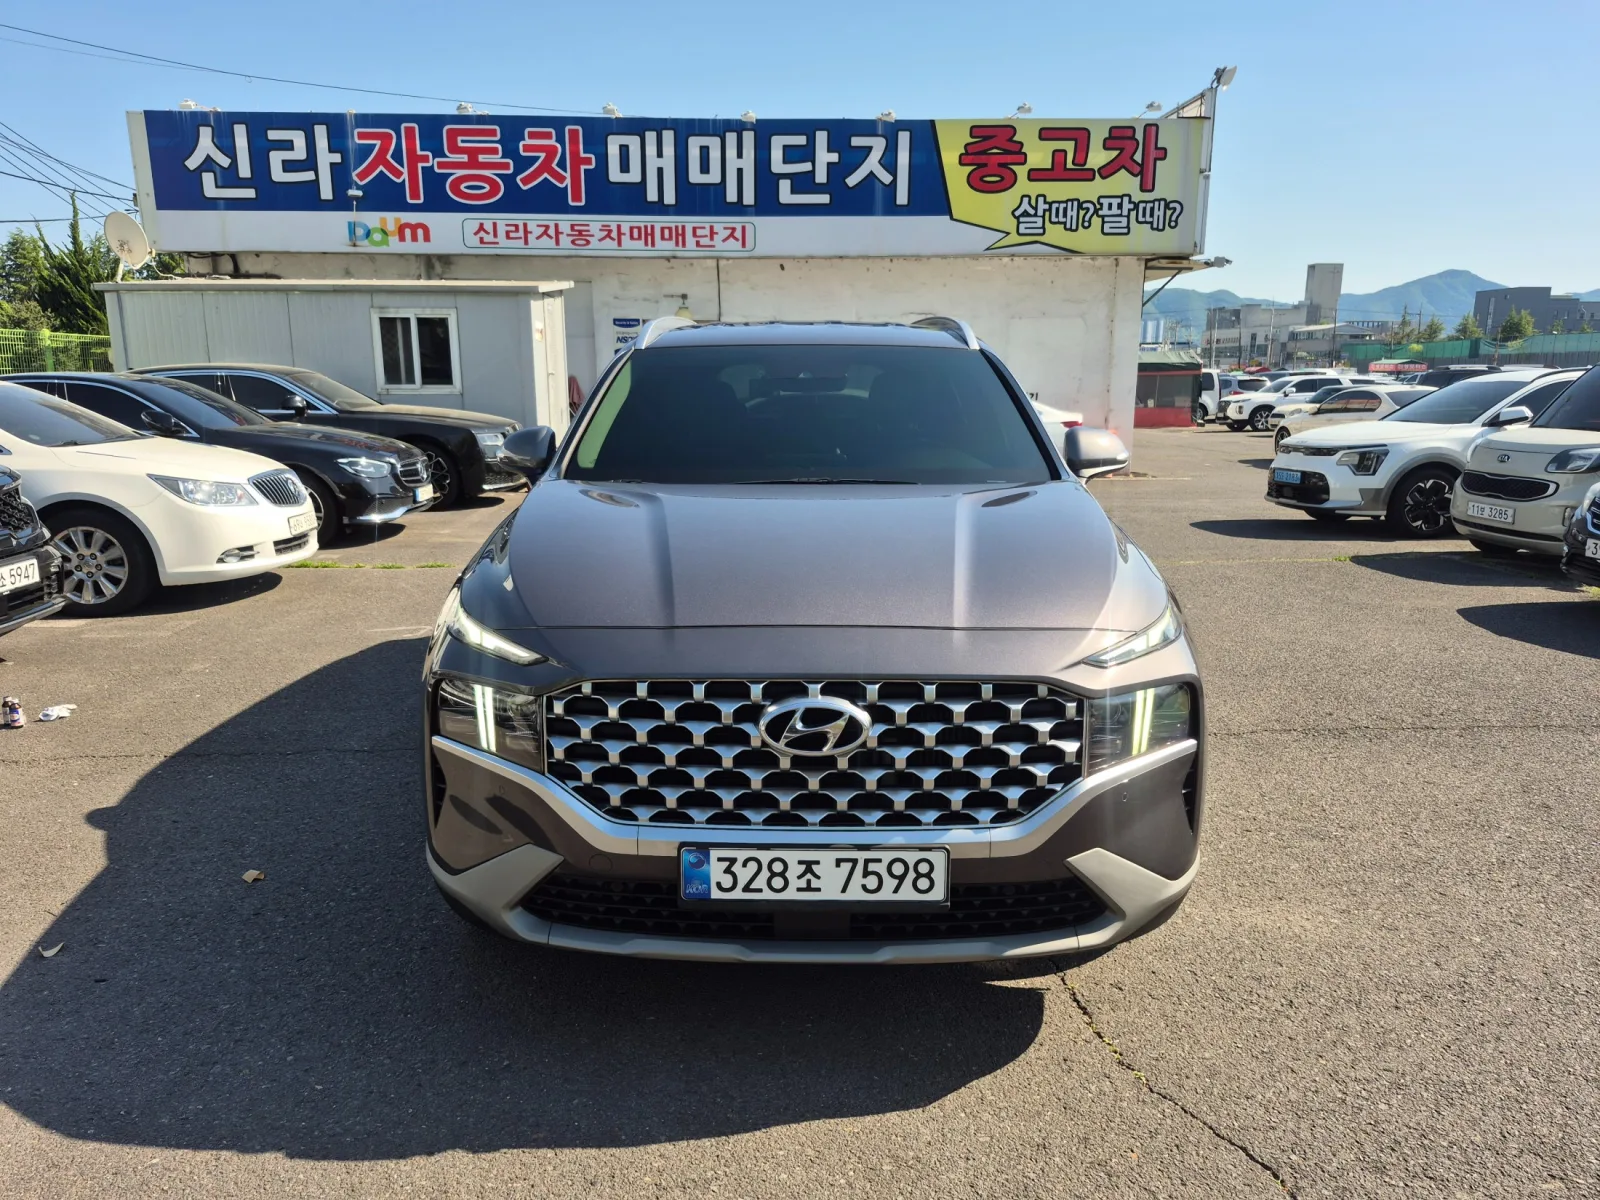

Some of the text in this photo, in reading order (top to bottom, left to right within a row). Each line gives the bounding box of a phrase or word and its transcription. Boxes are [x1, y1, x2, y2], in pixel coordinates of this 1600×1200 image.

[959, 124, 1168, 194] 중고차
[347, 216, 431, 248] Daum
[473, 221, 748, 249] 신라자동차매매단지
[1488, 506, 1509, 521] 3285
[9, 563, 35, 586] 5947
[715, 856, 936, 895] 328조 7598
